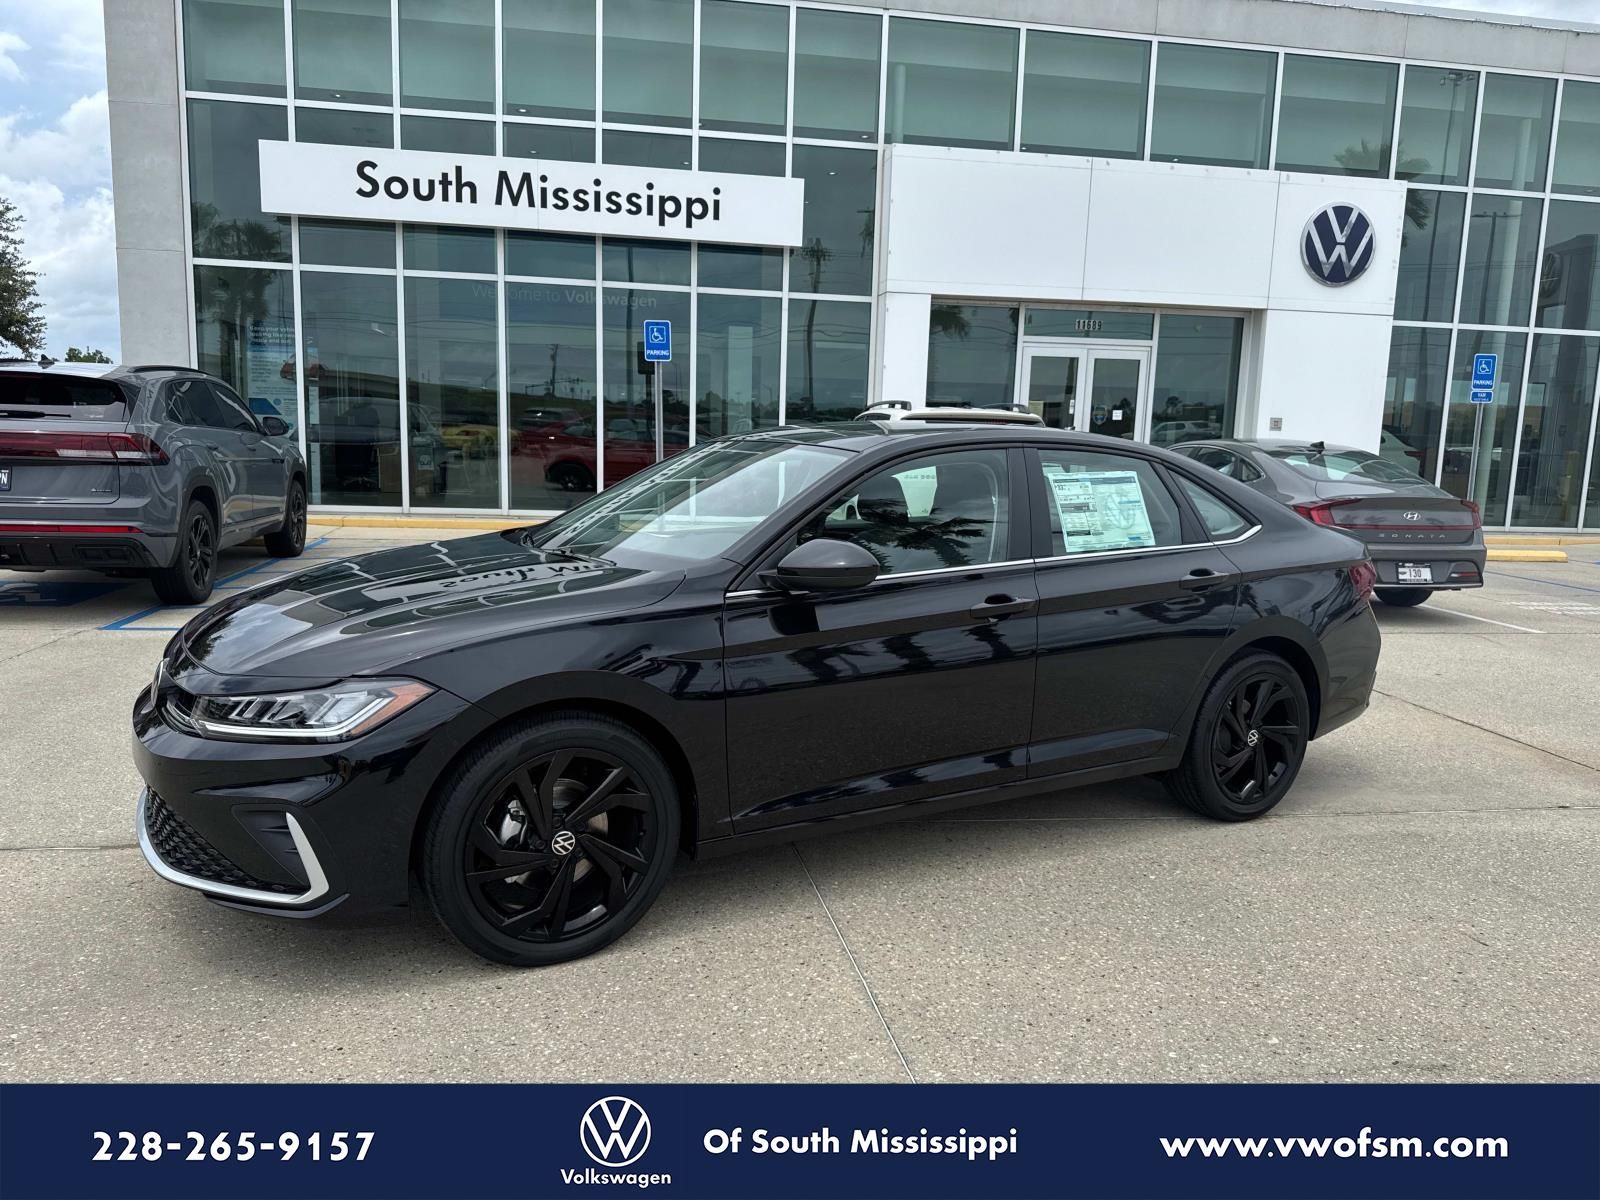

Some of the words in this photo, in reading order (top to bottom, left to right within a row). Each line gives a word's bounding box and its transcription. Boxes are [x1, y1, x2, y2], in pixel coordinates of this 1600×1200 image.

[356, 160, 478, 204] South
[494, 170, 721, 228] Mississippi
[1303, 204, 1375, 285] VW
[472, 282, 541, 301] Weome
